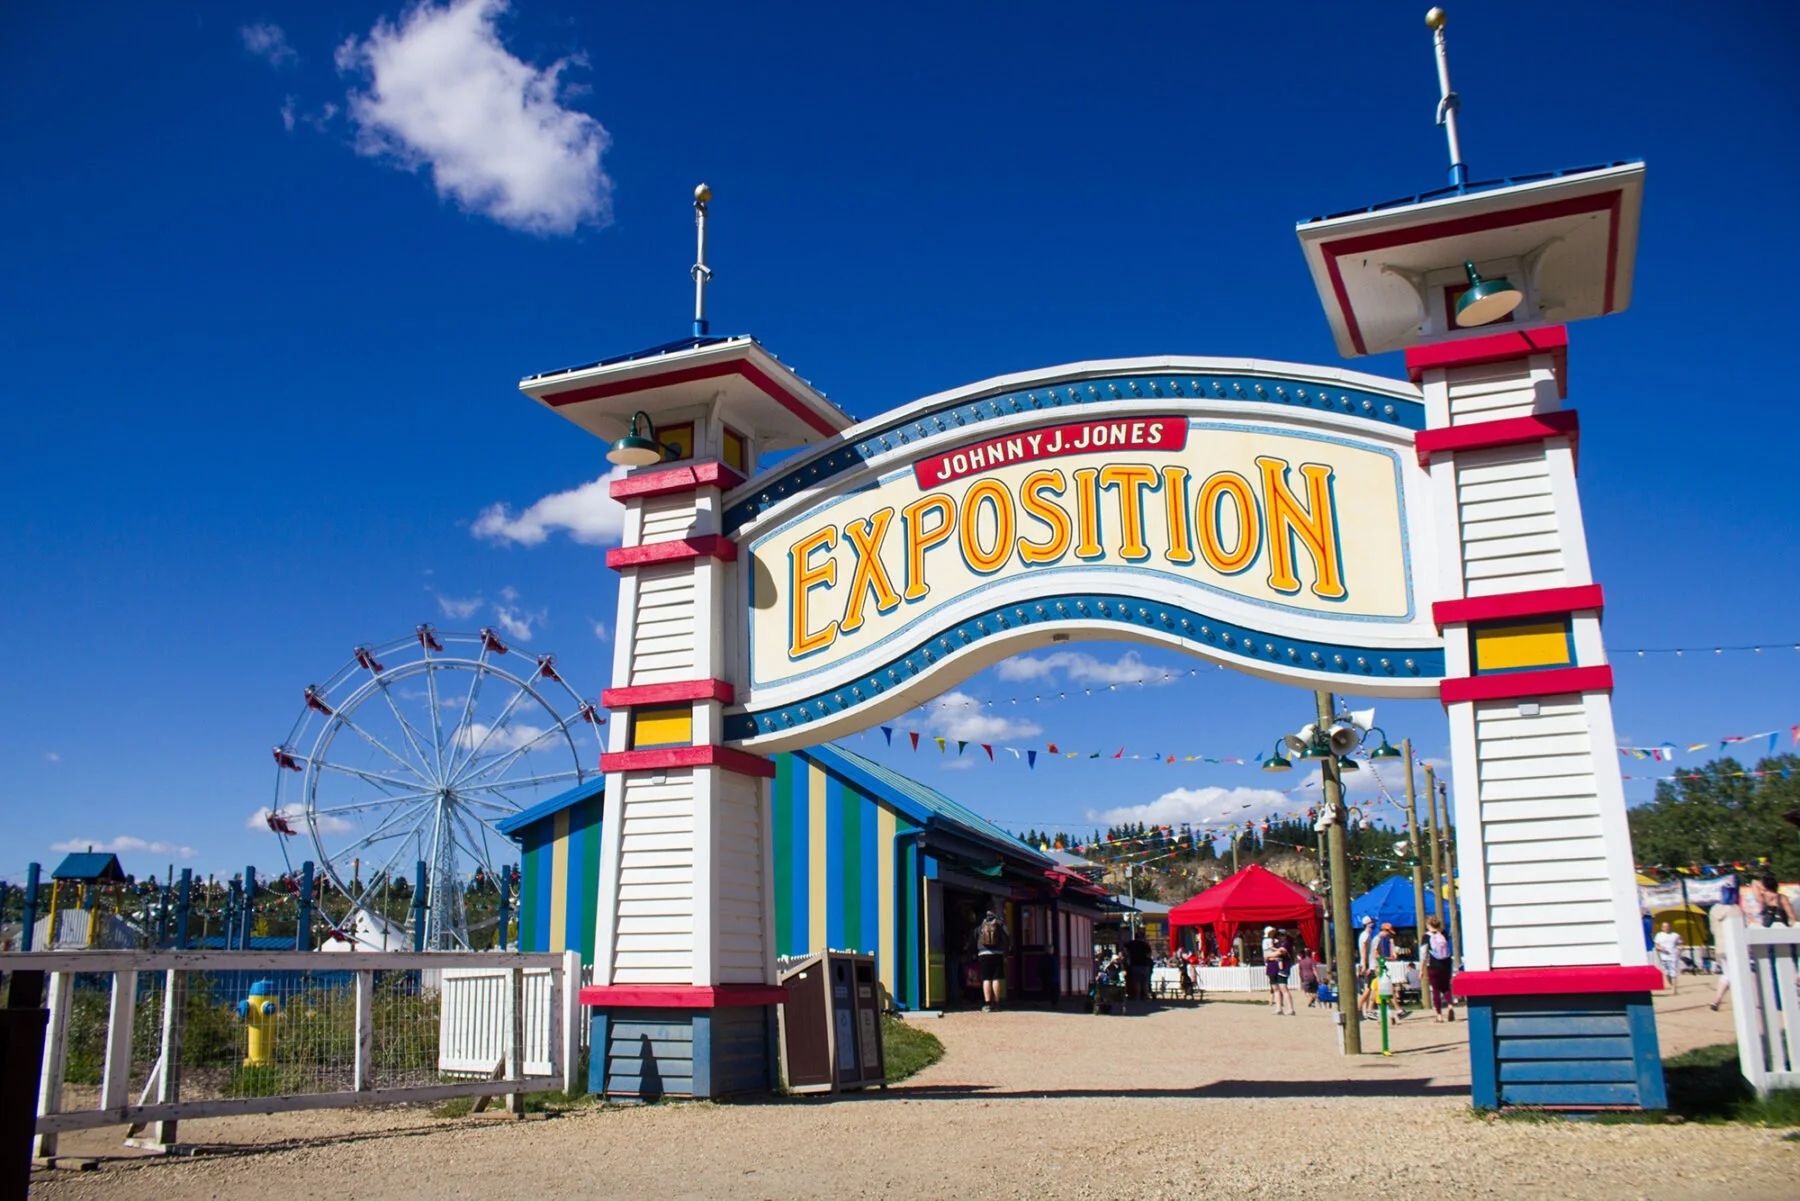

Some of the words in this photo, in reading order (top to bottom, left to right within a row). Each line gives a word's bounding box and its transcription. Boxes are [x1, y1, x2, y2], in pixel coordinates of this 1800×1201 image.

[937, 433, 1043, 480] JOHNNY
[1074, 422, 1164, 449] JONES
[788, 455, 1348, 659] EXPOSITION
